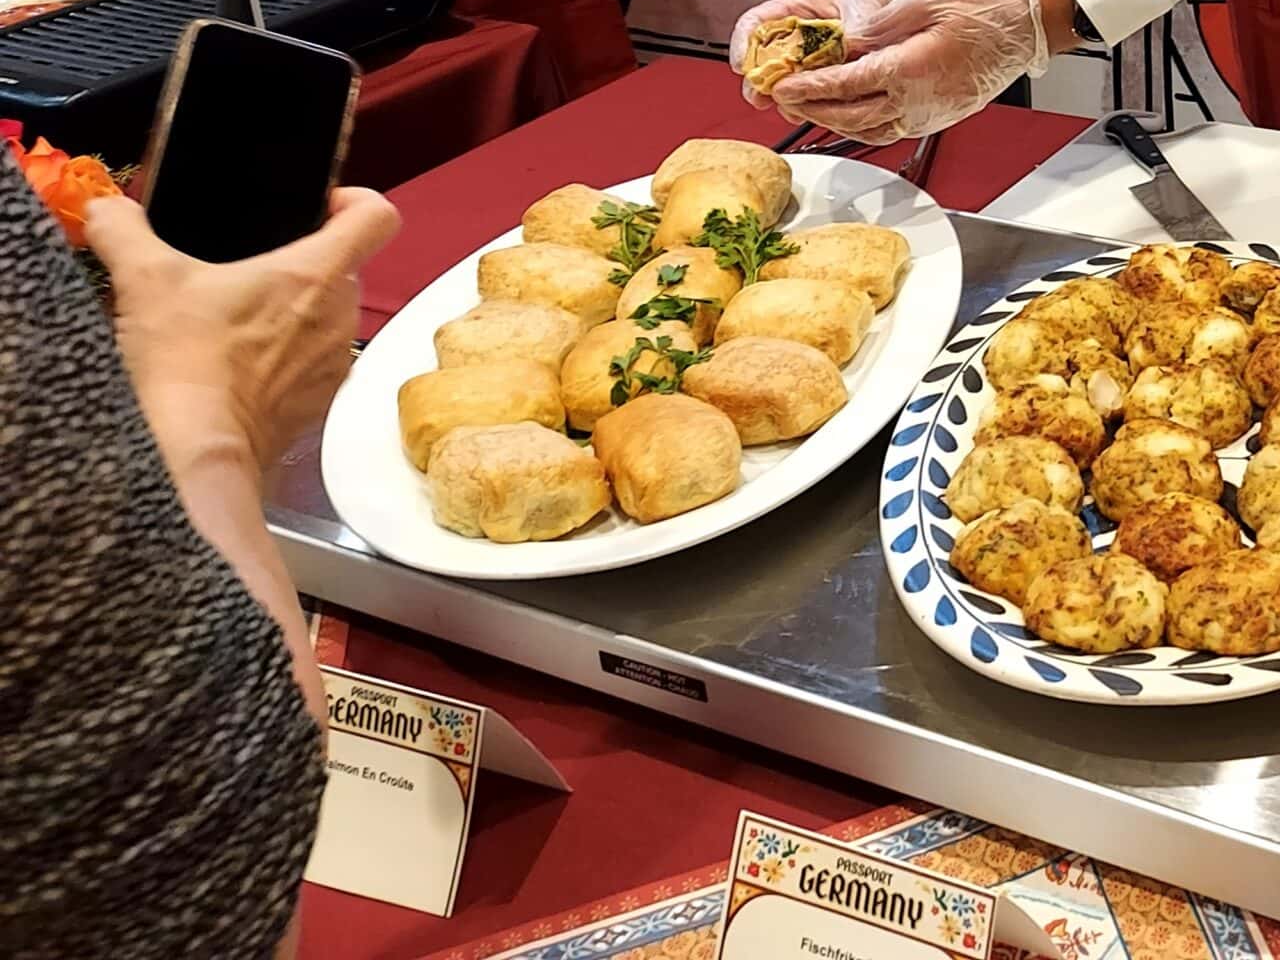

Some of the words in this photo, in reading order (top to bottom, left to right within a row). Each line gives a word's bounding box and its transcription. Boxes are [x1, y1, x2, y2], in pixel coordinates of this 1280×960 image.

[351, 686, 399, 708] PASSPORT
[328, 760, 360, 777] almon
[361, 766, 377, 781] En
[836, 856, 894, 886] PASSPORT
[799, 863, 924, 930] GERMANY
